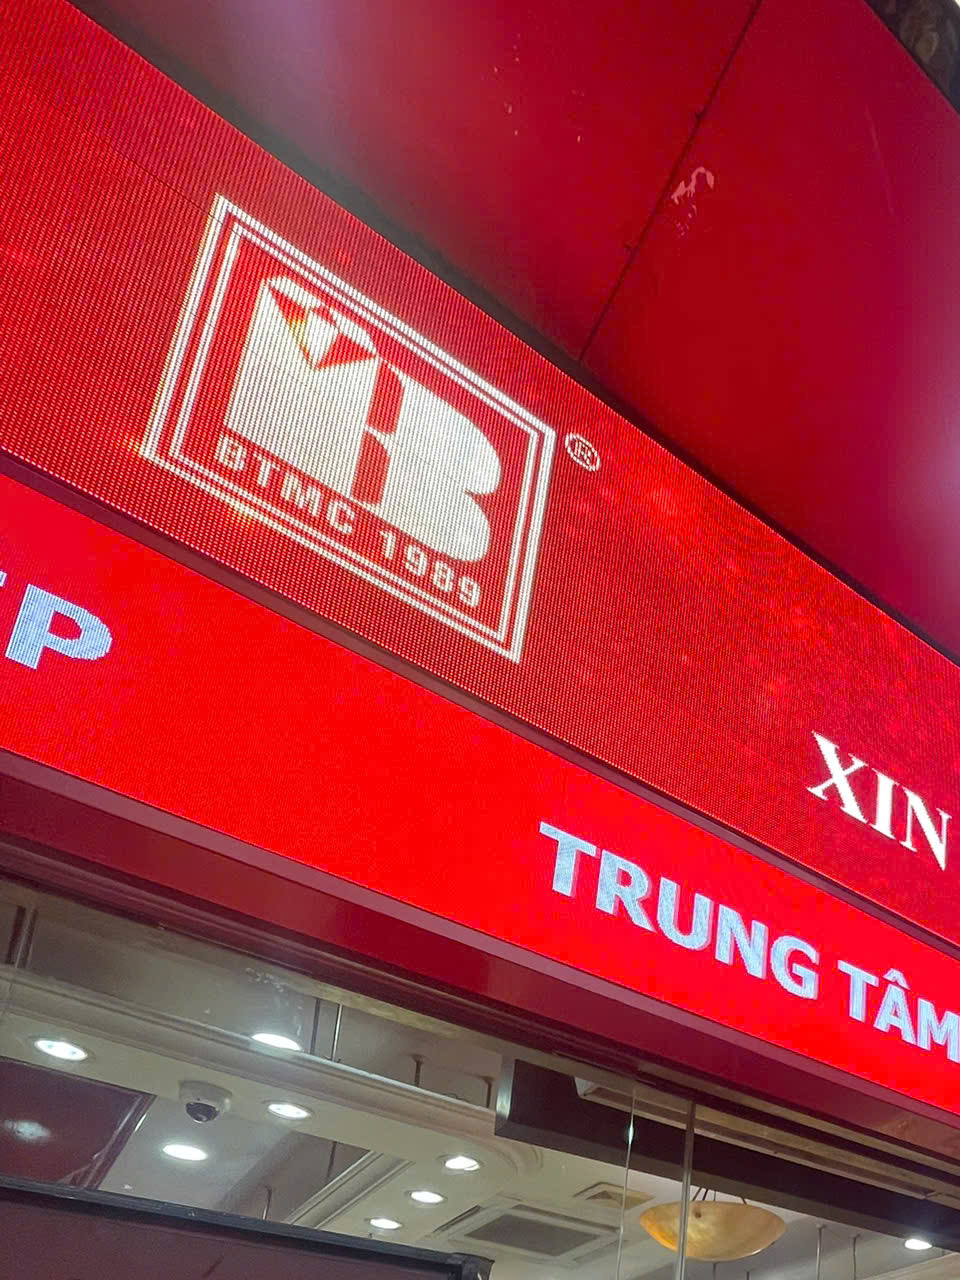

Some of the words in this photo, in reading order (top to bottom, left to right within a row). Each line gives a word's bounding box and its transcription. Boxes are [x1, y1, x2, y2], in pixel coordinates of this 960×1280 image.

[216, 435, 356, 537] BTMC
[379, 529, 483, 606] 1989
[807, 730, 953, 871] XIN
[538, 822, 821, 1000] TRUNG
